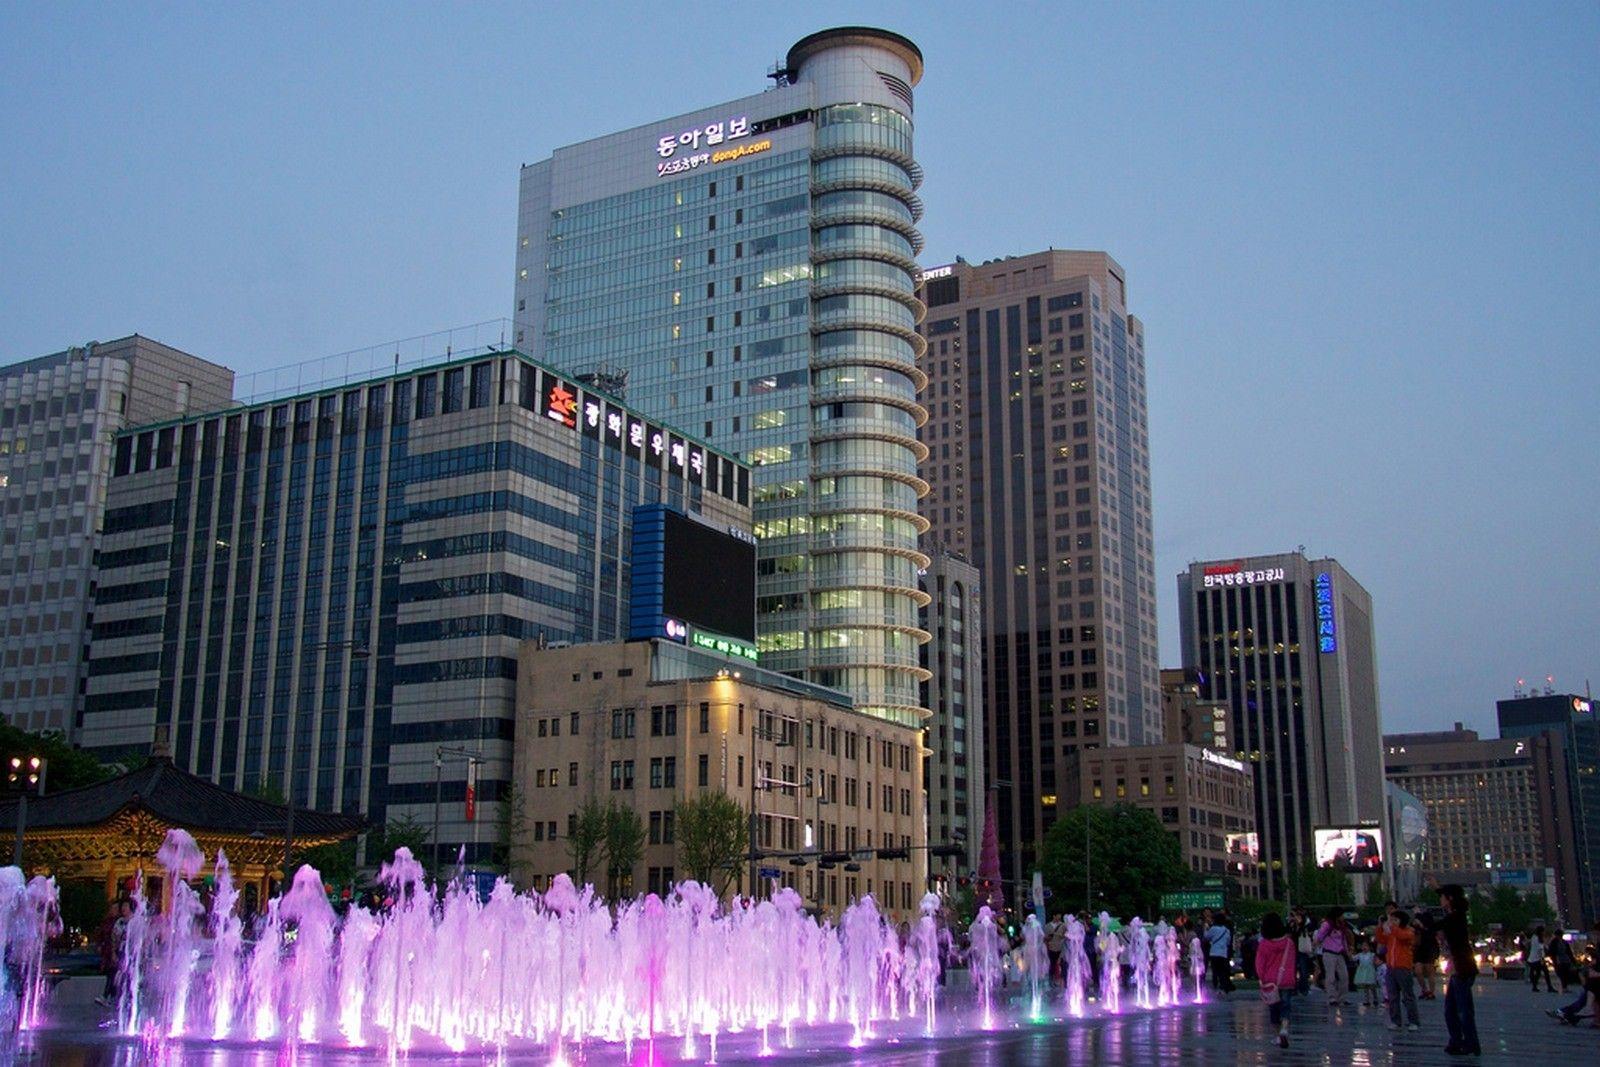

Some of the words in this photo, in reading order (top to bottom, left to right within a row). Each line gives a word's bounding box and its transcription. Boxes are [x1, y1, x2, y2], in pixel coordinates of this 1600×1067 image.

[657, 116, 750, 158] 동아일보
[711, 140, 771, 164] dongA.com
[914, 266, 952, 281] ENTER
[1204, 568, 1284, 587] 한국방송광고공사
